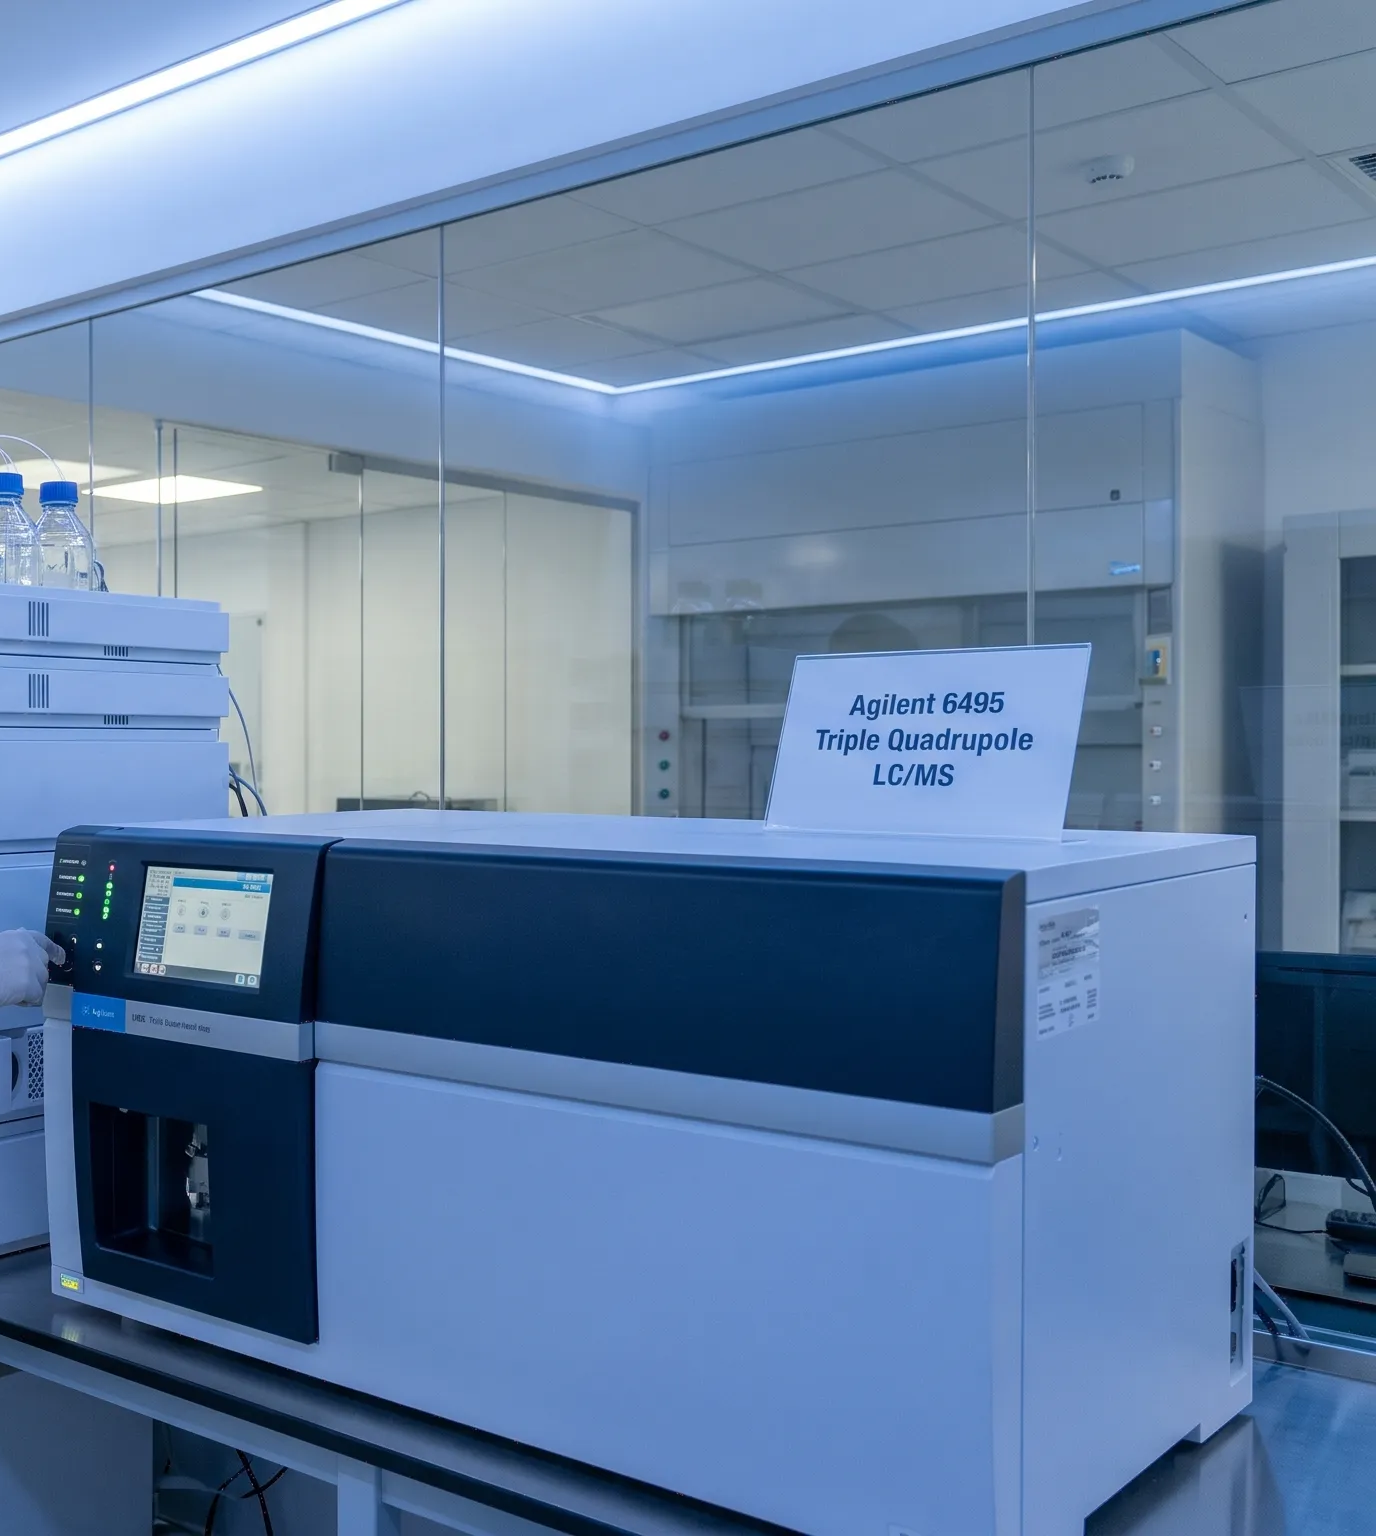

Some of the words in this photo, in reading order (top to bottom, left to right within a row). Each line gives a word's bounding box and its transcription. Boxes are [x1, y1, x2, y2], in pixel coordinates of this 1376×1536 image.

[848, 693, 936, 720] Agilent
[942, 691, 1005, 714] 6495
[815, 728, 880, 756] Triple
[887, 727, 1034, 756] Quadrupole
[872, 763, 955, 786] LC/MS
